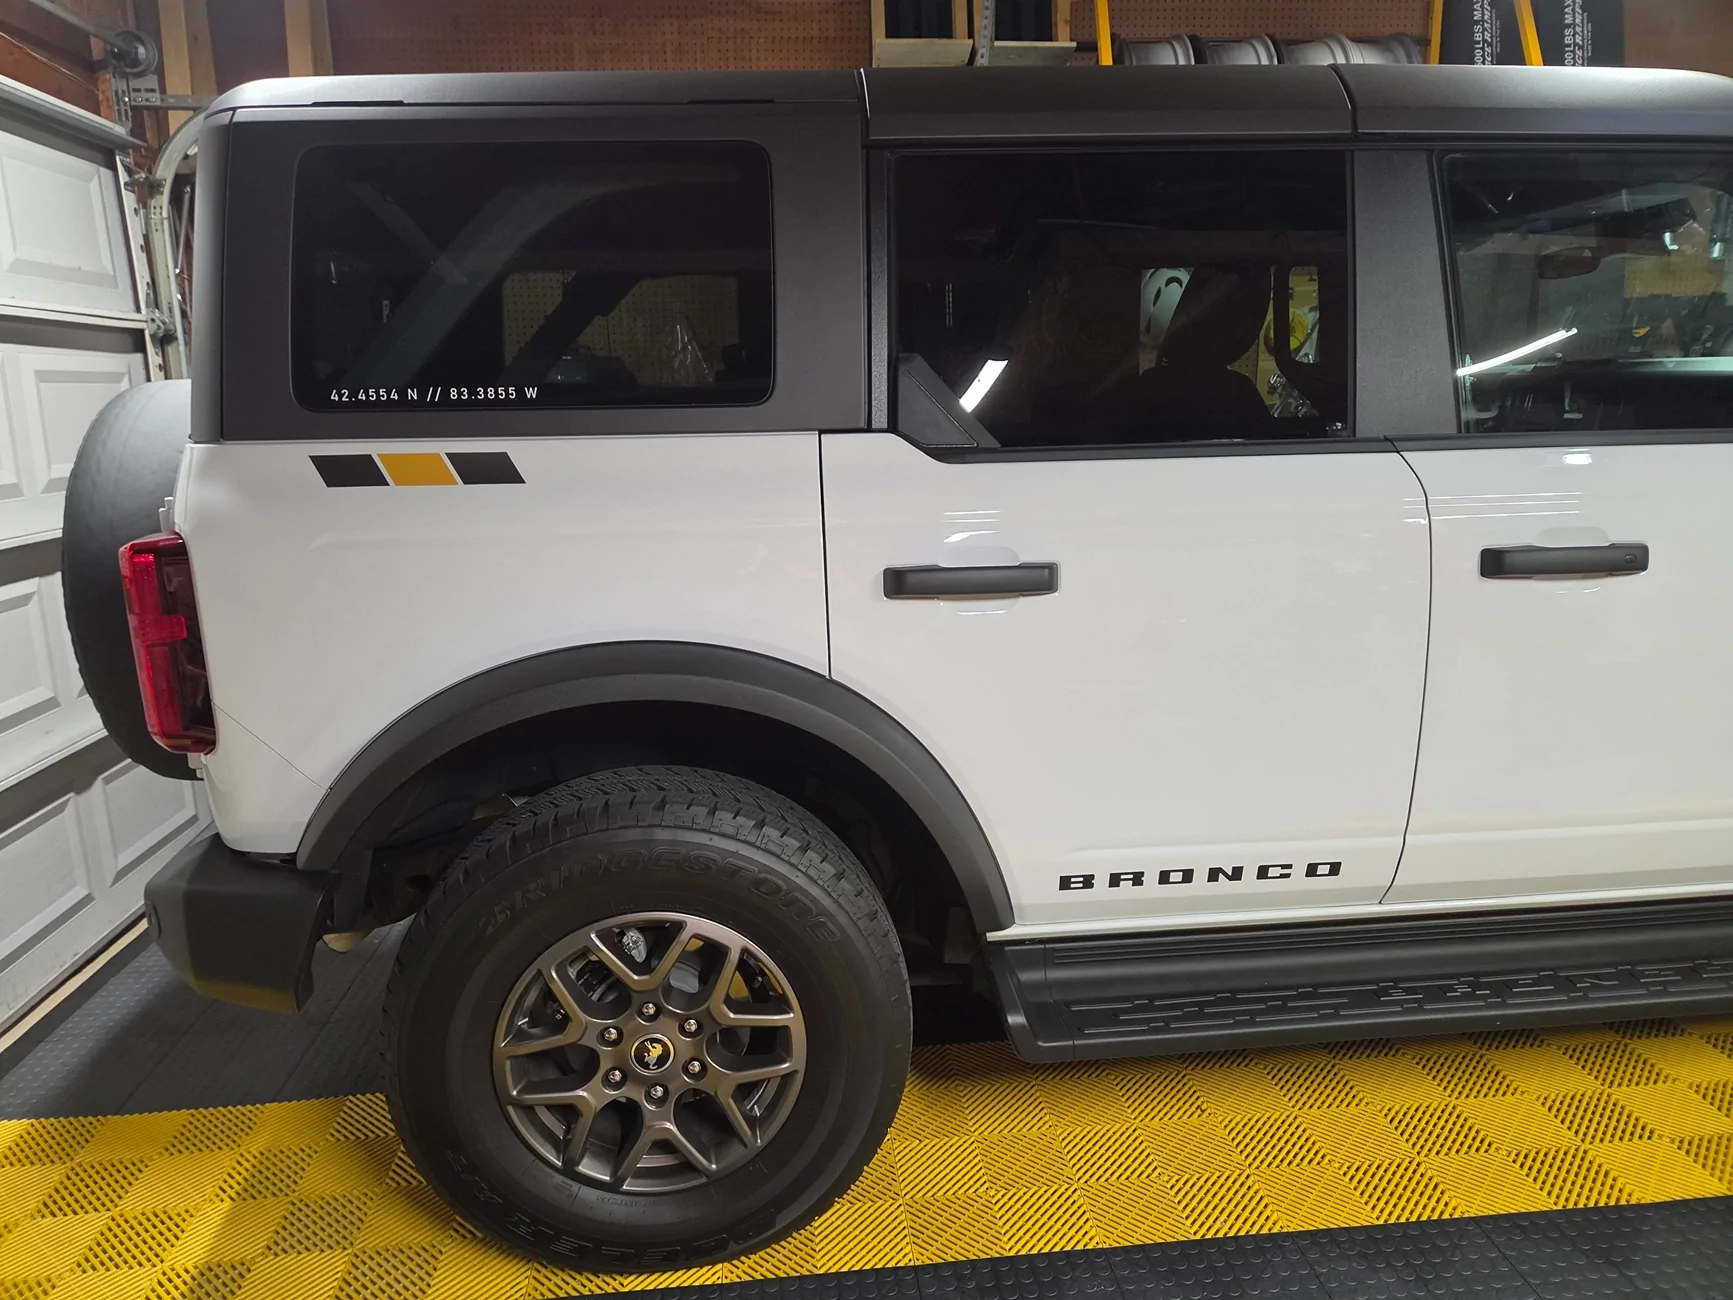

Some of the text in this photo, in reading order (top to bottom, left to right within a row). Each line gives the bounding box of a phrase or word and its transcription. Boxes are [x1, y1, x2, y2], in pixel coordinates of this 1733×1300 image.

[1473, 0, 1482, 20] MA
[1484, 0, 1492, 42] RAMP
[1473, 22, 1483, 47] LBS.
[1564, 25, 1574, 50] LBS.
[330, 386, 538, 402] 42.4554 N // 83.3855 W
[1058, 861, 1342, 891] BRONCO
[476, 845, 842, 942] BRIDGESTONE
